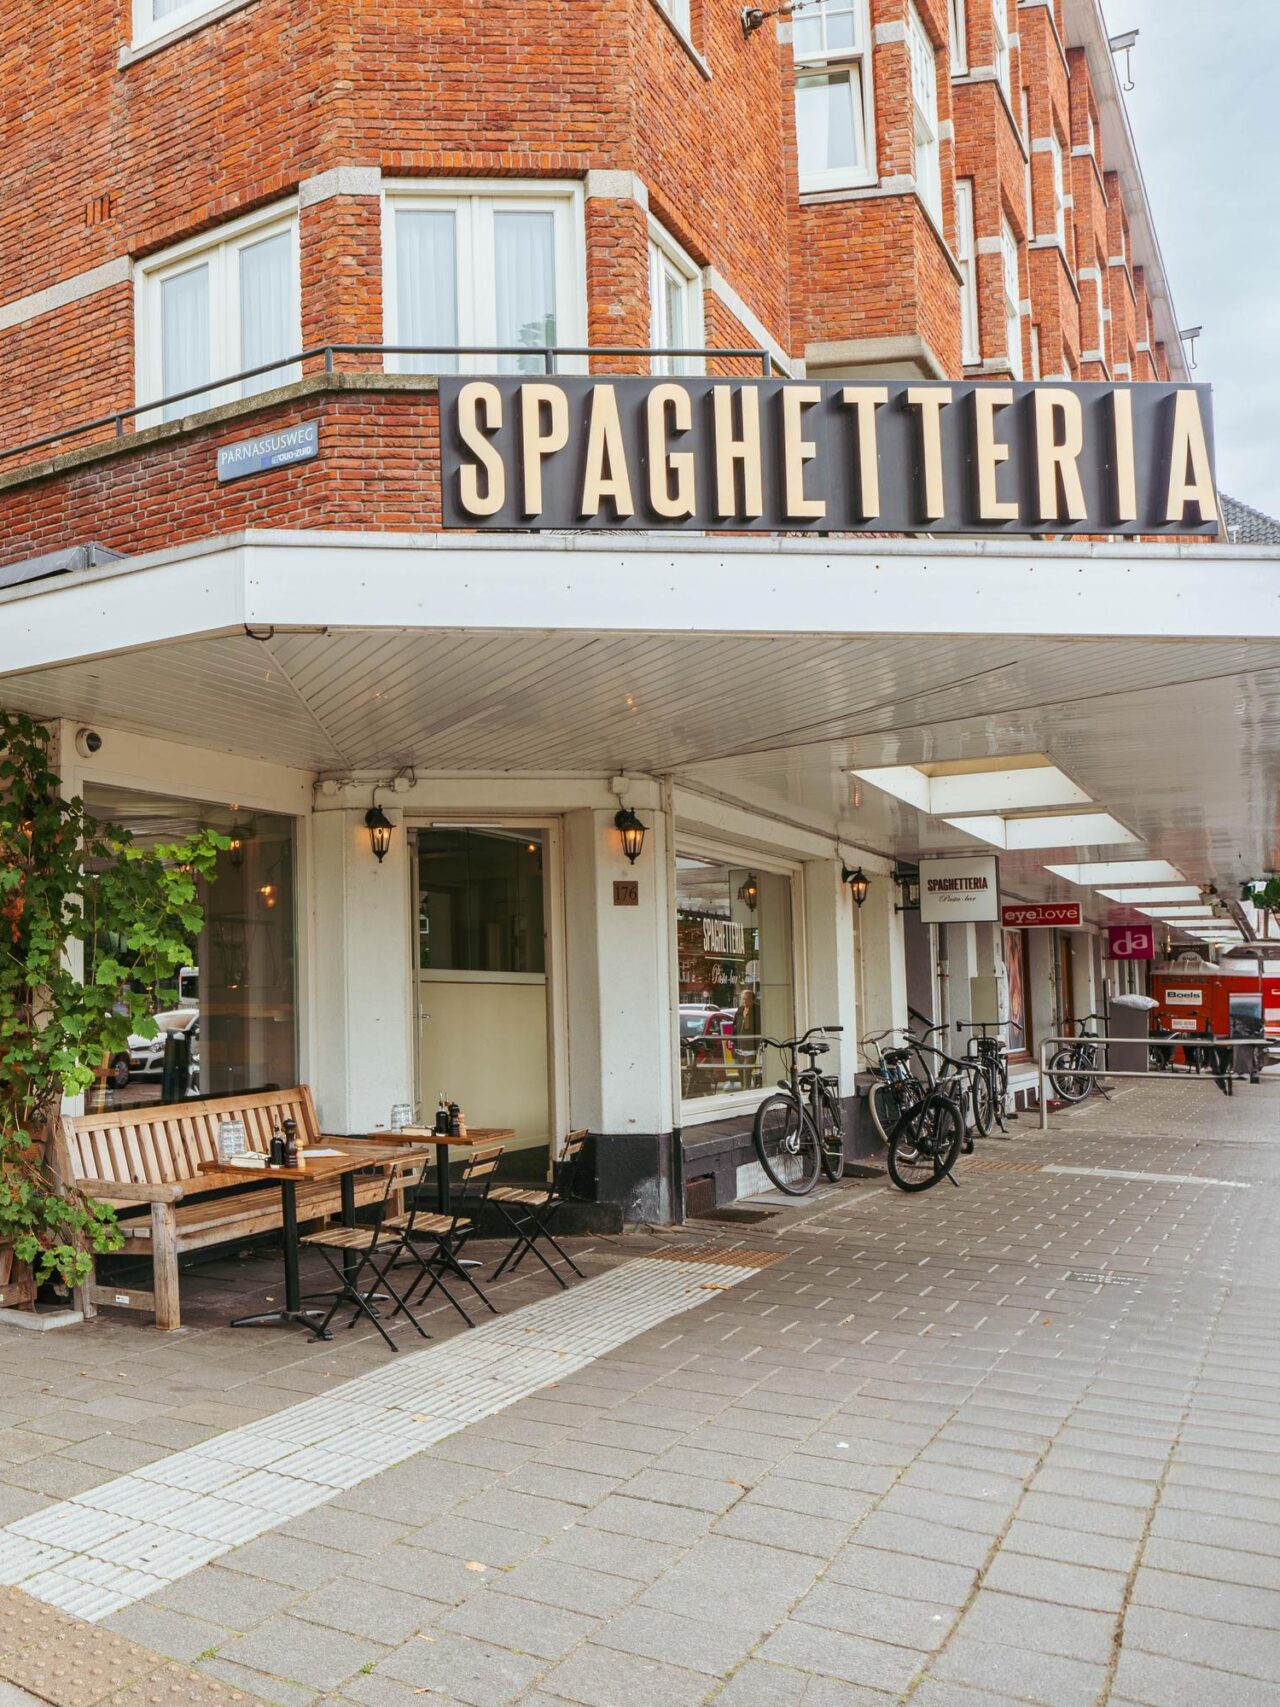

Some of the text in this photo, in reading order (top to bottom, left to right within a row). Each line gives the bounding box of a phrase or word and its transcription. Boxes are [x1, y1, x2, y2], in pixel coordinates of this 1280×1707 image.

[222, 428, 313, 465] PARNASSUSWEG
[457, 381, 1217, 522] SPAGHETTERIA
[616, 886, 637, 901] 176
[927, 877, 988, 891] SPAGHETTERIA
[1005, 908, 1078, 923] eyelove
[703, 917, 745, 954] SPAGHETTERIA
[1112, 931, 1148, 955] da
[1167, 991, 1200, 999] Boels
